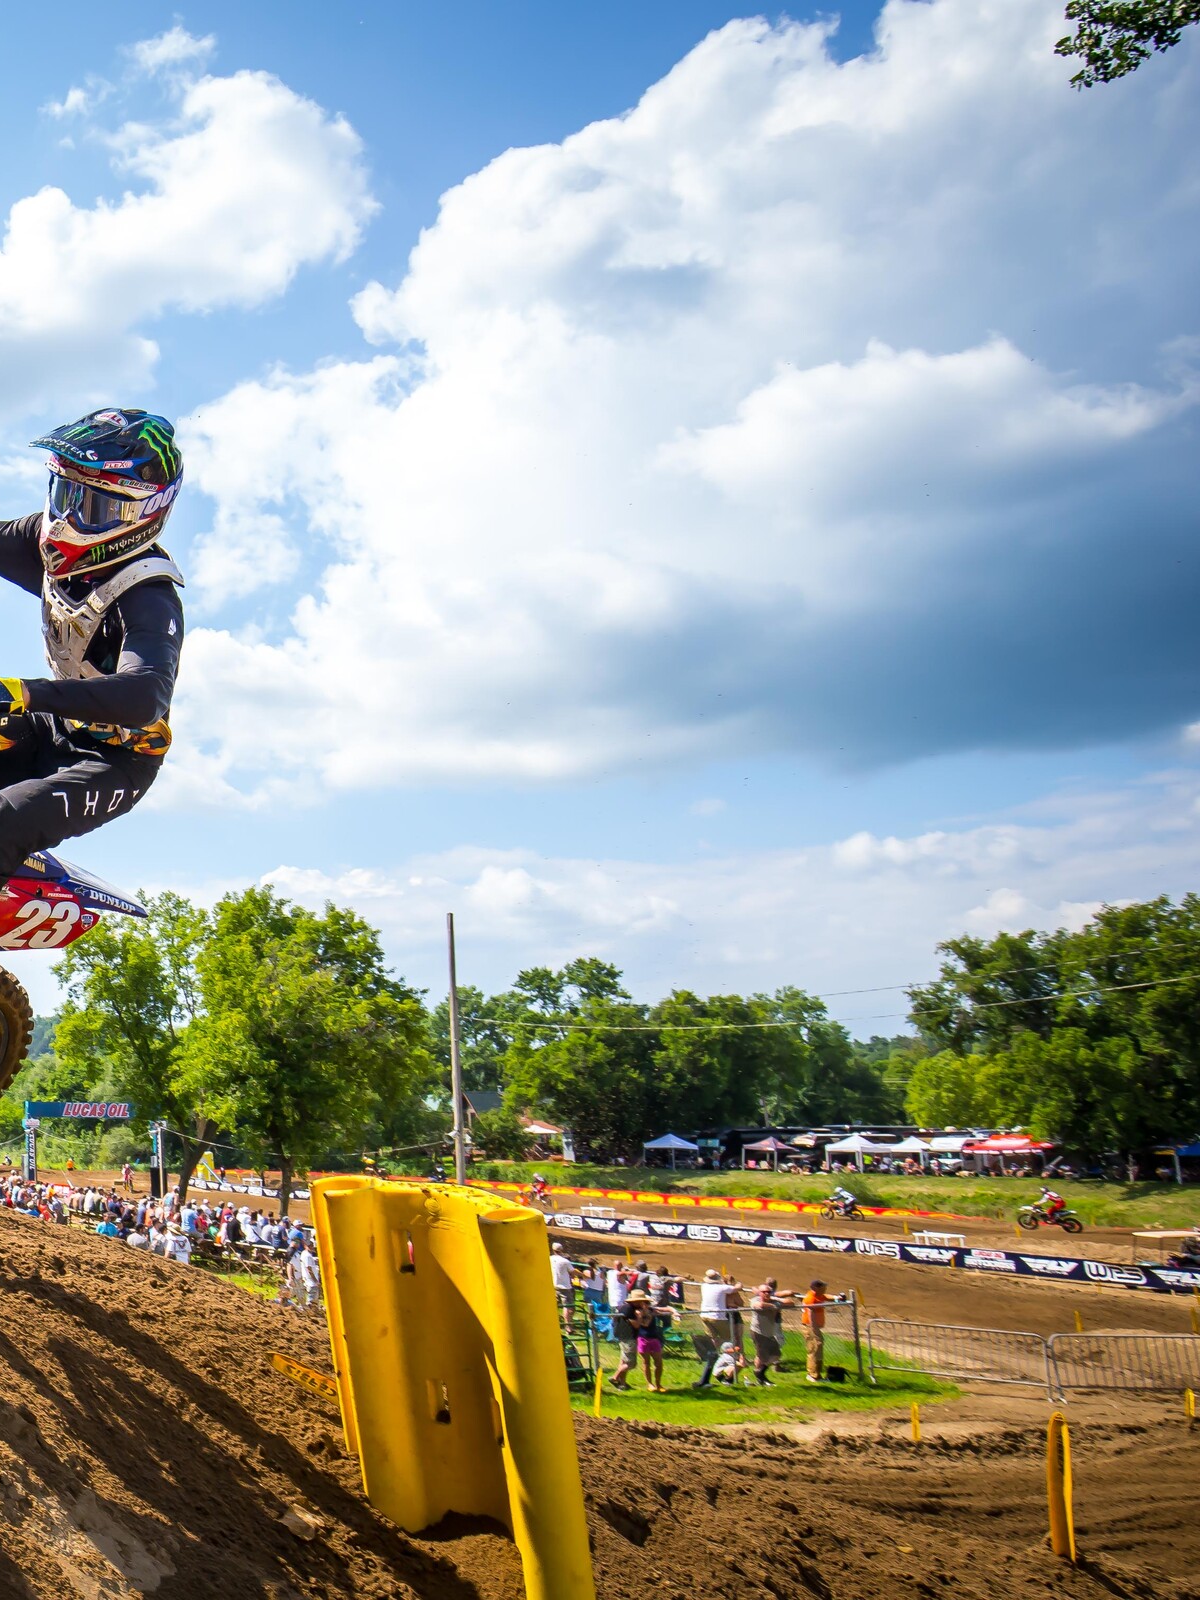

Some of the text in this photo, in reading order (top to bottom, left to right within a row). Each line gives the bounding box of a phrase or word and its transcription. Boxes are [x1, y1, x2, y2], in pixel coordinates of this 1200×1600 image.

[23, 856, 46, 874] AMAHA
[89, 889, 136, 913] DUNLOP
[62, 1102, 130, 1118] LUCAS OIL
[854, 1239, 901, 1260] WPS
[1083, 1260, 1147, 1285] WPS
